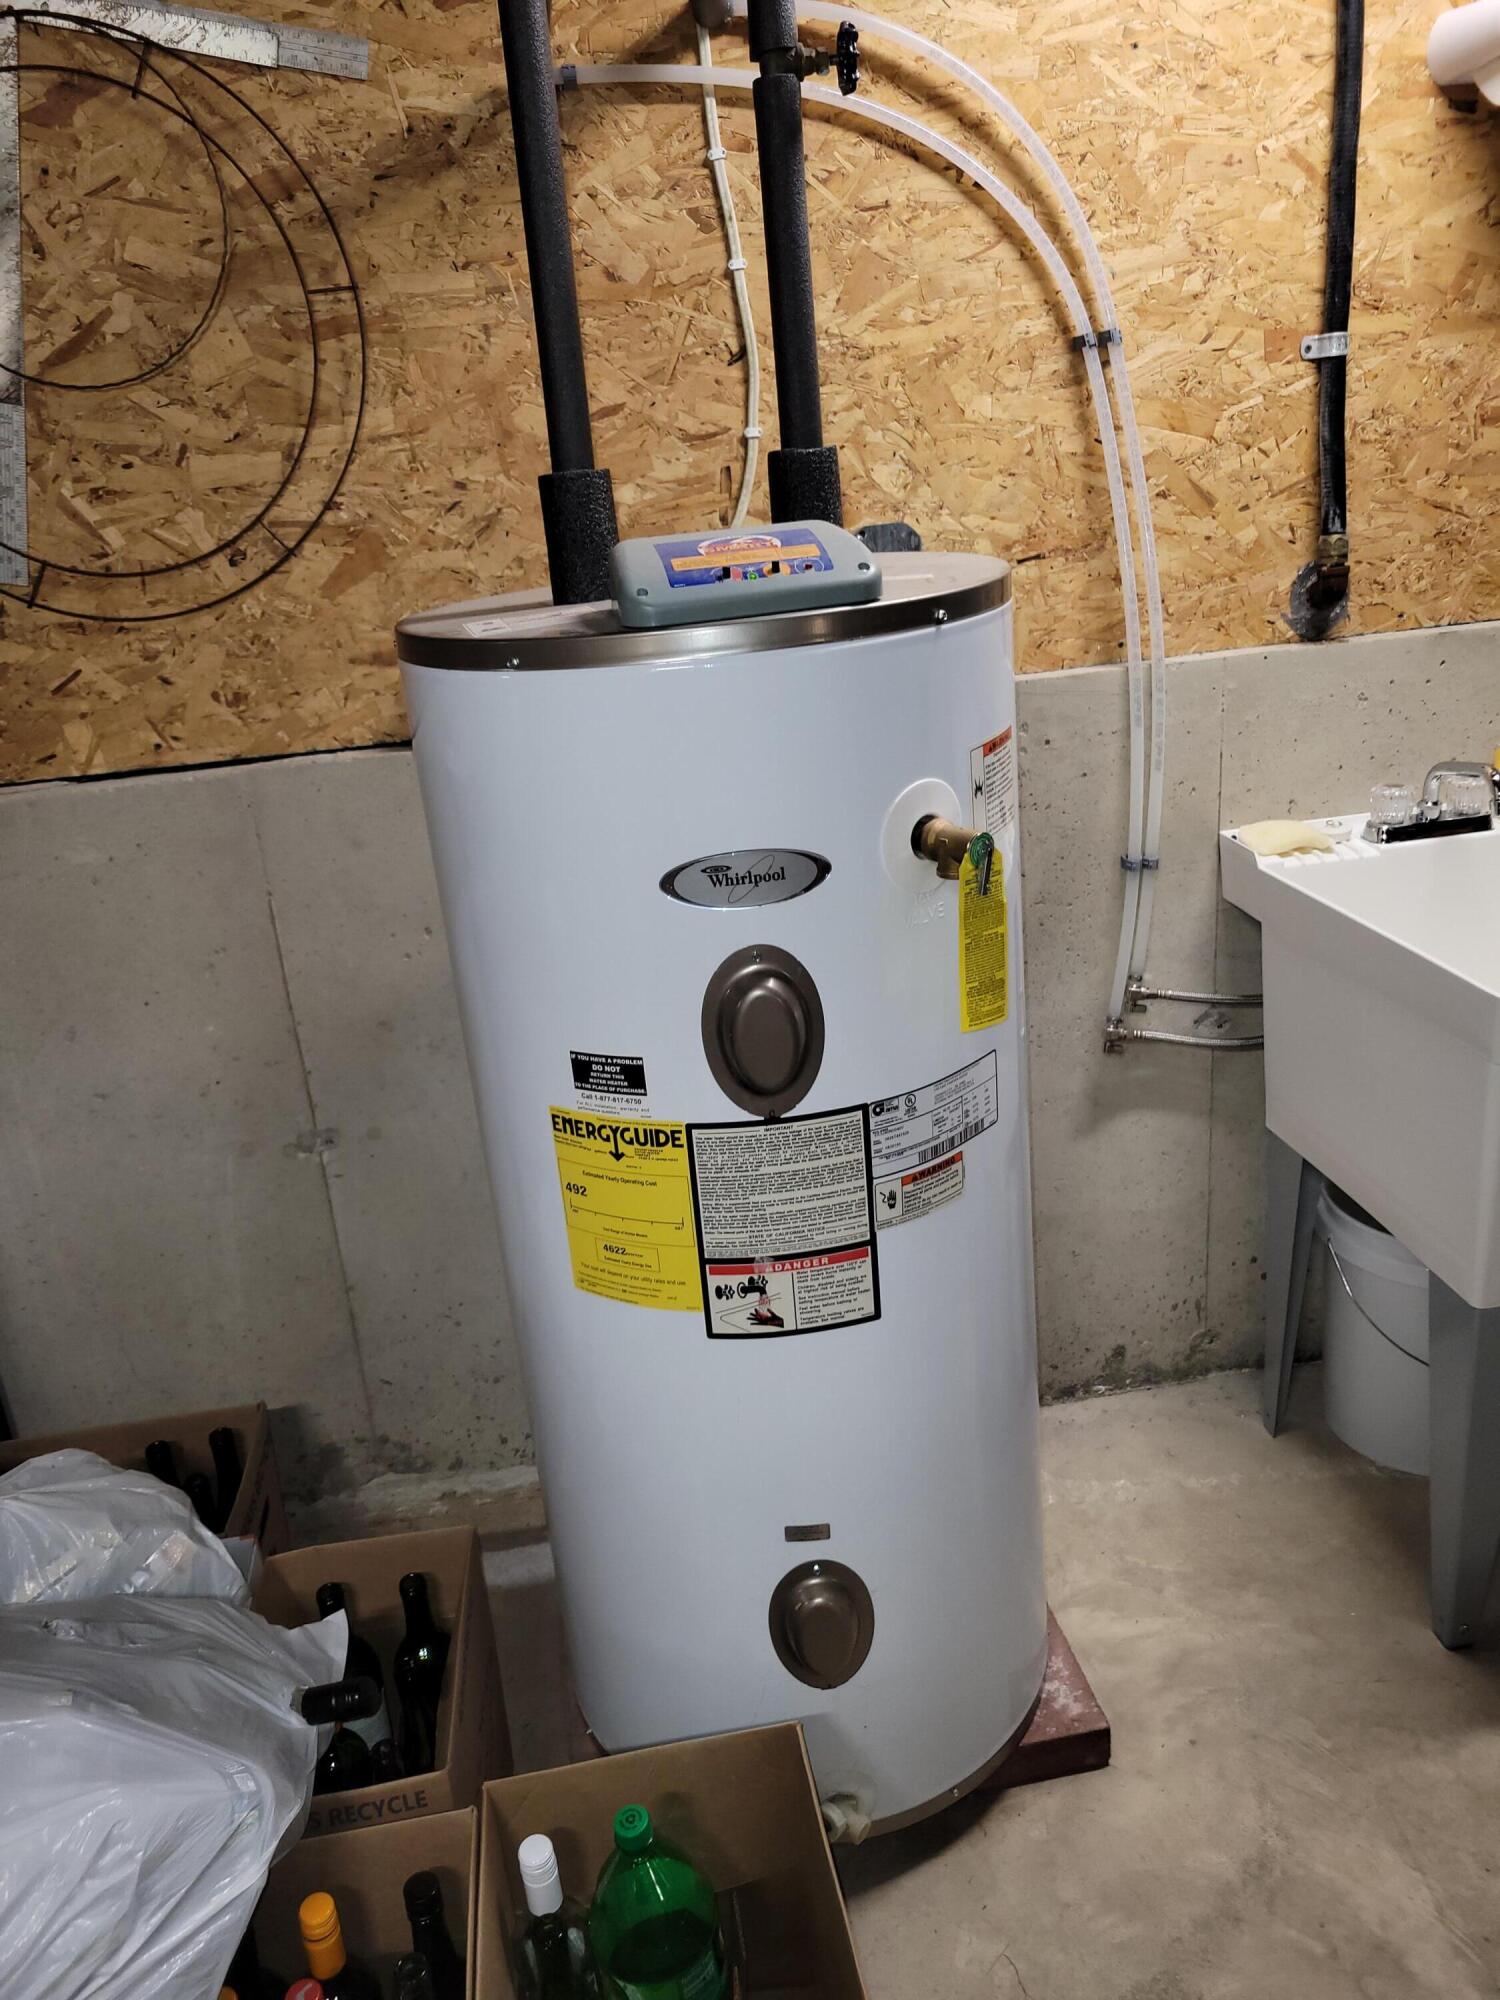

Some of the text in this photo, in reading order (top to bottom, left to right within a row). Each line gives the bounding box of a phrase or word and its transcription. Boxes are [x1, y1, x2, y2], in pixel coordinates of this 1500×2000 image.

[706, 867, 786, 888] Whirlpool
[613, 1057, 642, 1065] PROBLEM
[551, 1114, 684, 1149] ENERGYGUIDE
[919, 1156, 955, 1178] WARNING
[582, 1170, 604, 1179] Estimated
[621, 1176, 644, 1185] Operating
[566, 1182, 588, 1197] 492
[603, 1244, 626, 1256] 4622
[775, 1257, 829, 1271] DANGER
[328, 1790, 428, 1827] RECYCLE
